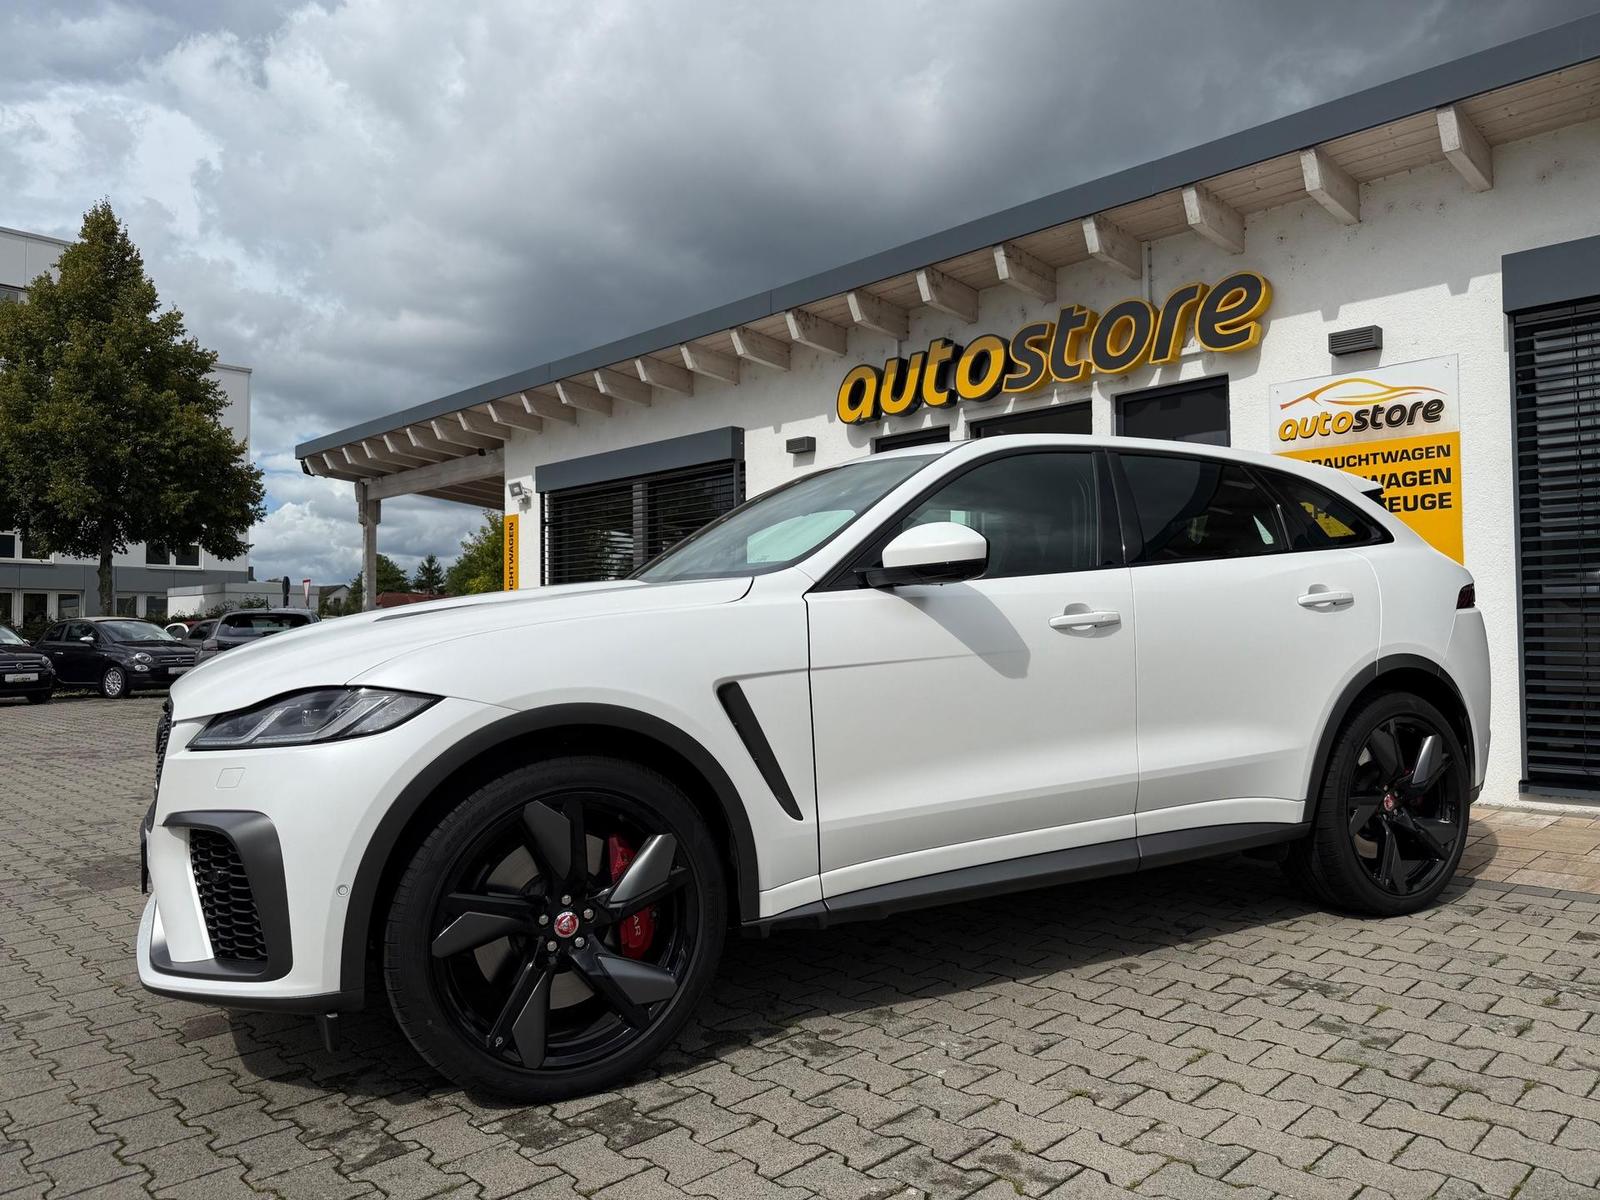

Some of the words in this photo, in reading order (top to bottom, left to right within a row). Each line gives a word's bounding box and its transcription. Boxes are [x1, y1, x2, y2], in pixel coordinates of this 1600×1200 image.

[837, 272, 1271, 424] autostore
[1278, 398, 1444, 442] autostore
[1306, 444, 1451, 469] AUCHTWAGEN
